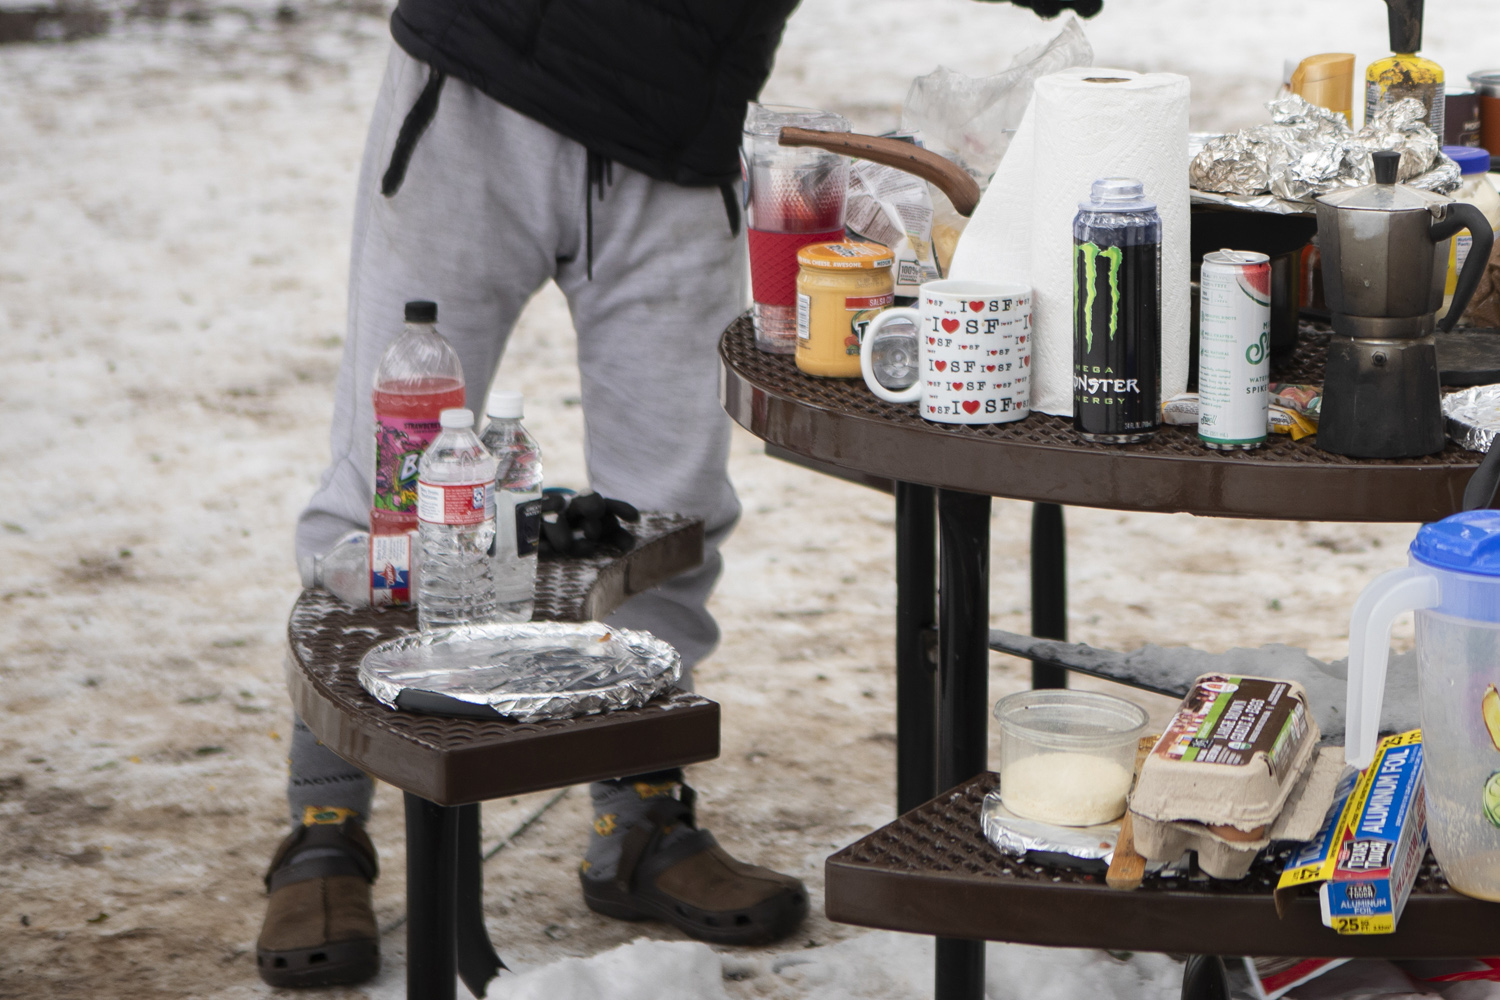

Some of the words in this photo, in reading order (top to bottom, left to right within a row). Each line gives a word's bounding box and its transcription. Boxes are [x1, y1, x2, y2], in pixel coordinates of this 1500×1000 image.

[869, 298, 885, 307] SALSA
[960, 300, 967, 312] I
[989, 299, 1012, 312] SF
[933, 316, 939, 332] I
[966, 319, 999, 334] SF
[929, 359, 934, 371] I
[951, 361, 975, 373] SF
[967, 382, 986, 391] SF
[1074, 372, 1140, 394] ONSTER
[952, 401, 960, 415] I
[986, 398, 1012, 413] SF
[1076, 395, 1125, 404] NERGY
[1362, 774, 1400, 834] ALUMINUM
[1381, 749, 1410, 773] FOIL
[1348, 842, 1369, 869] TEXAS
[1341, 899, 1386, 909] ALUMINUM
[1339, 918, 1359, 932] 25
